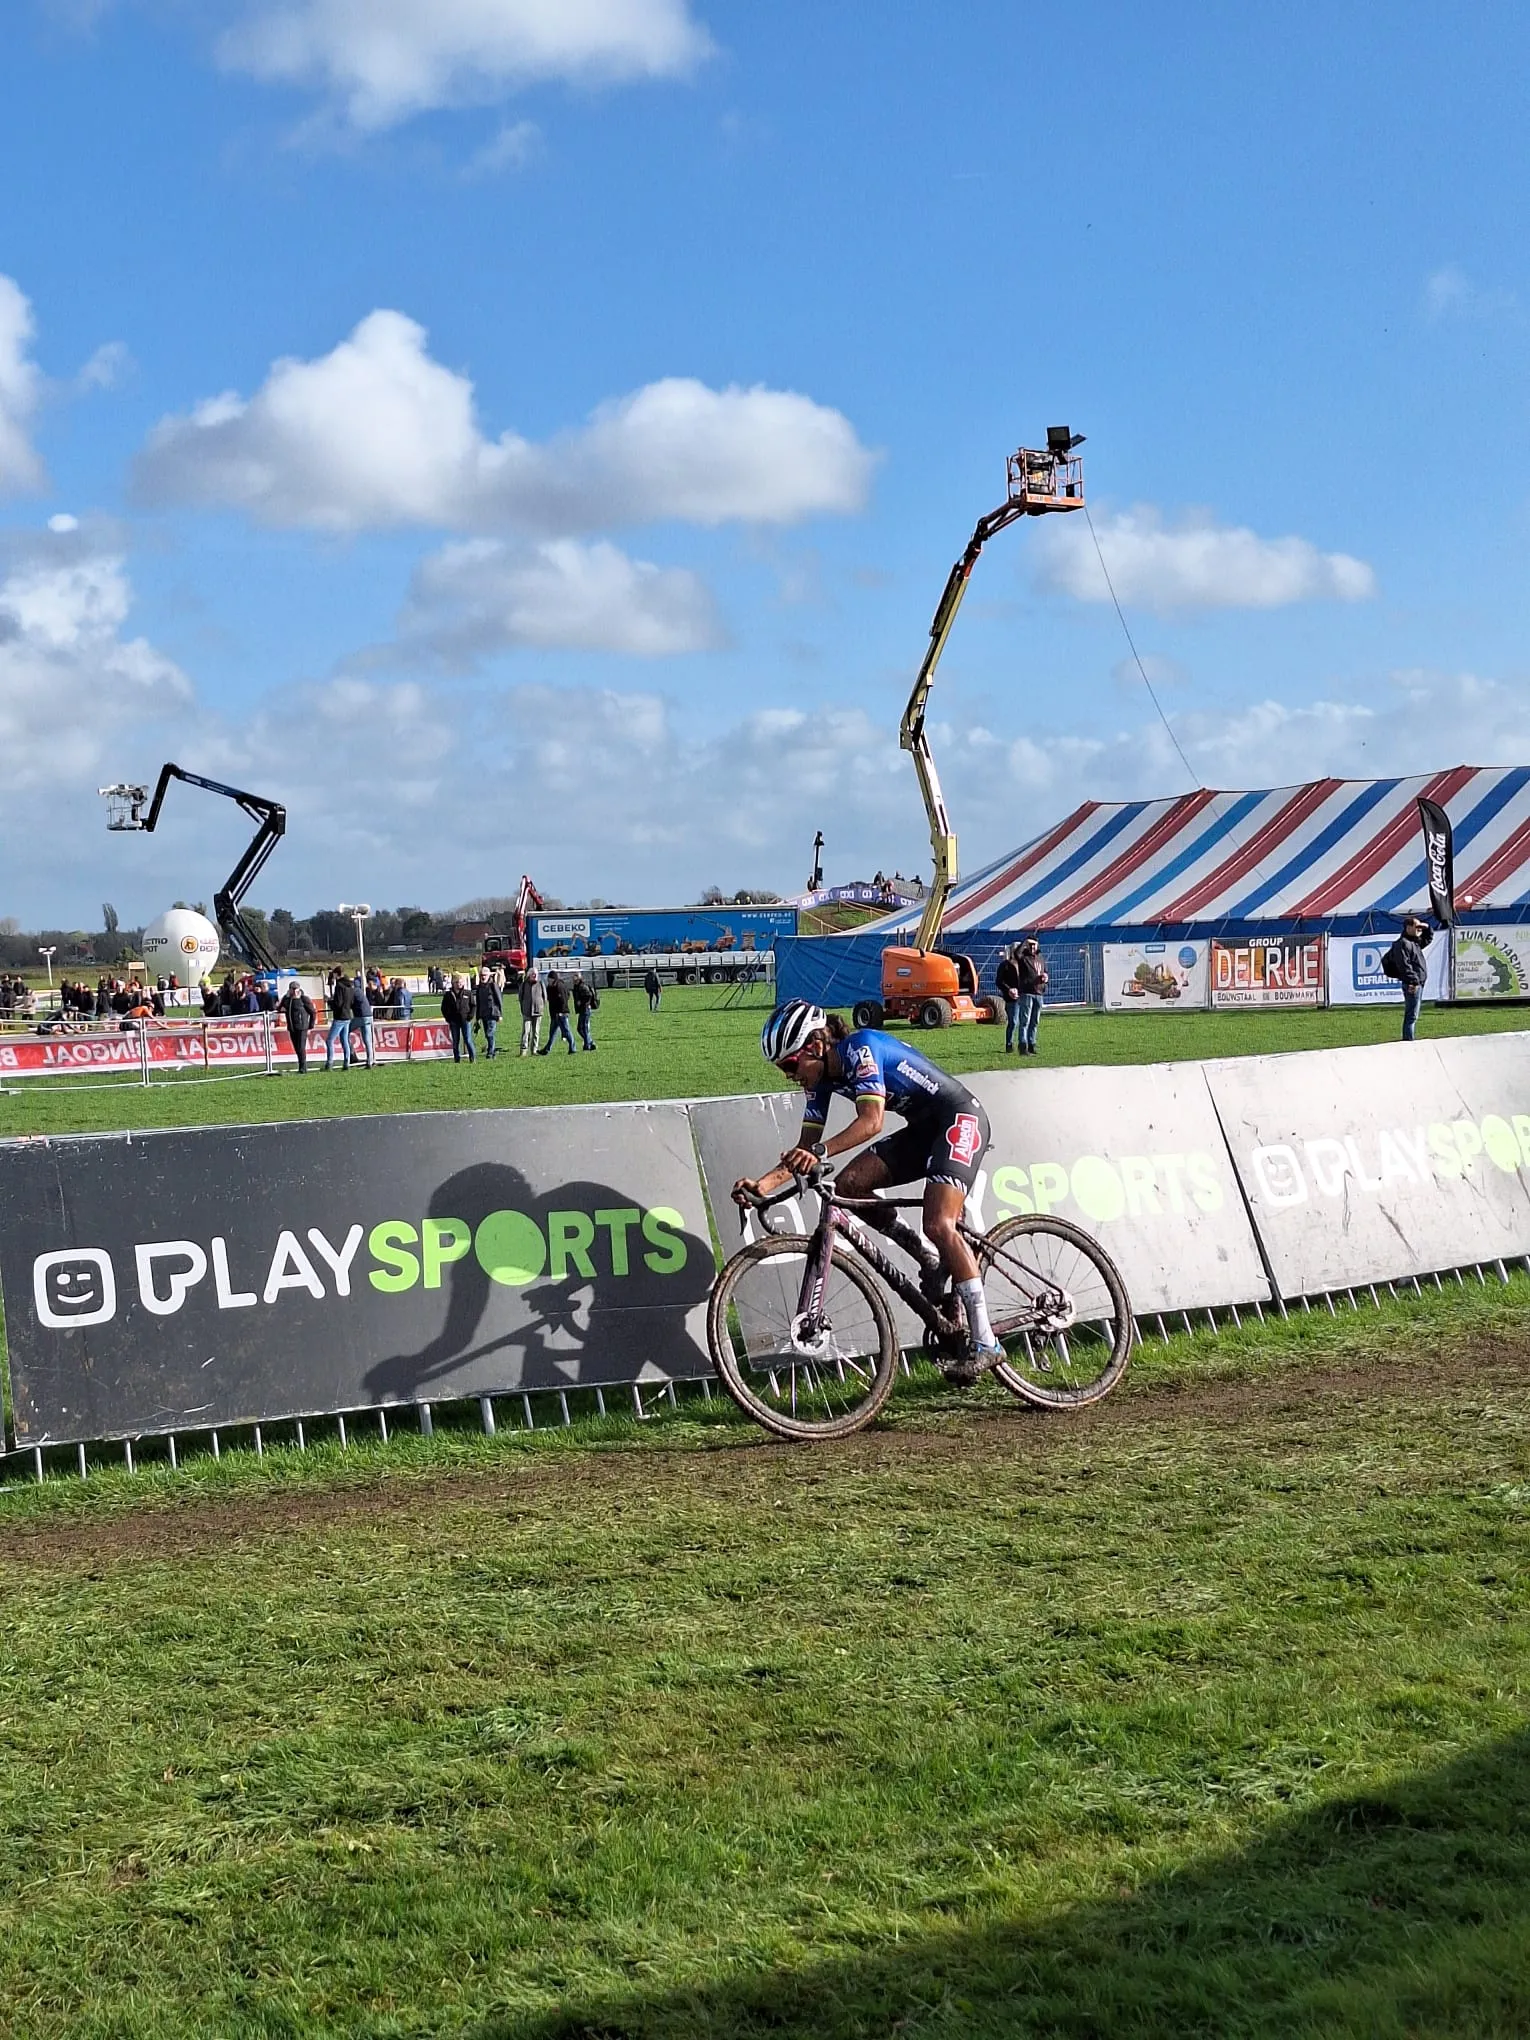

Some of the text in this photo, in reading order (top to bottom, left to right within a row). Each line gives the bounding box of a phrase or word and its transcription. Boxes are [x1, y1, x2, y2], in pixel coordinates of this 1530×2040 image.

[542, 924, 586, 933] CEBEKO
[1248, 937, 1284, 948] GROUP
[1216, 945, 1319, 988] DELRUE
